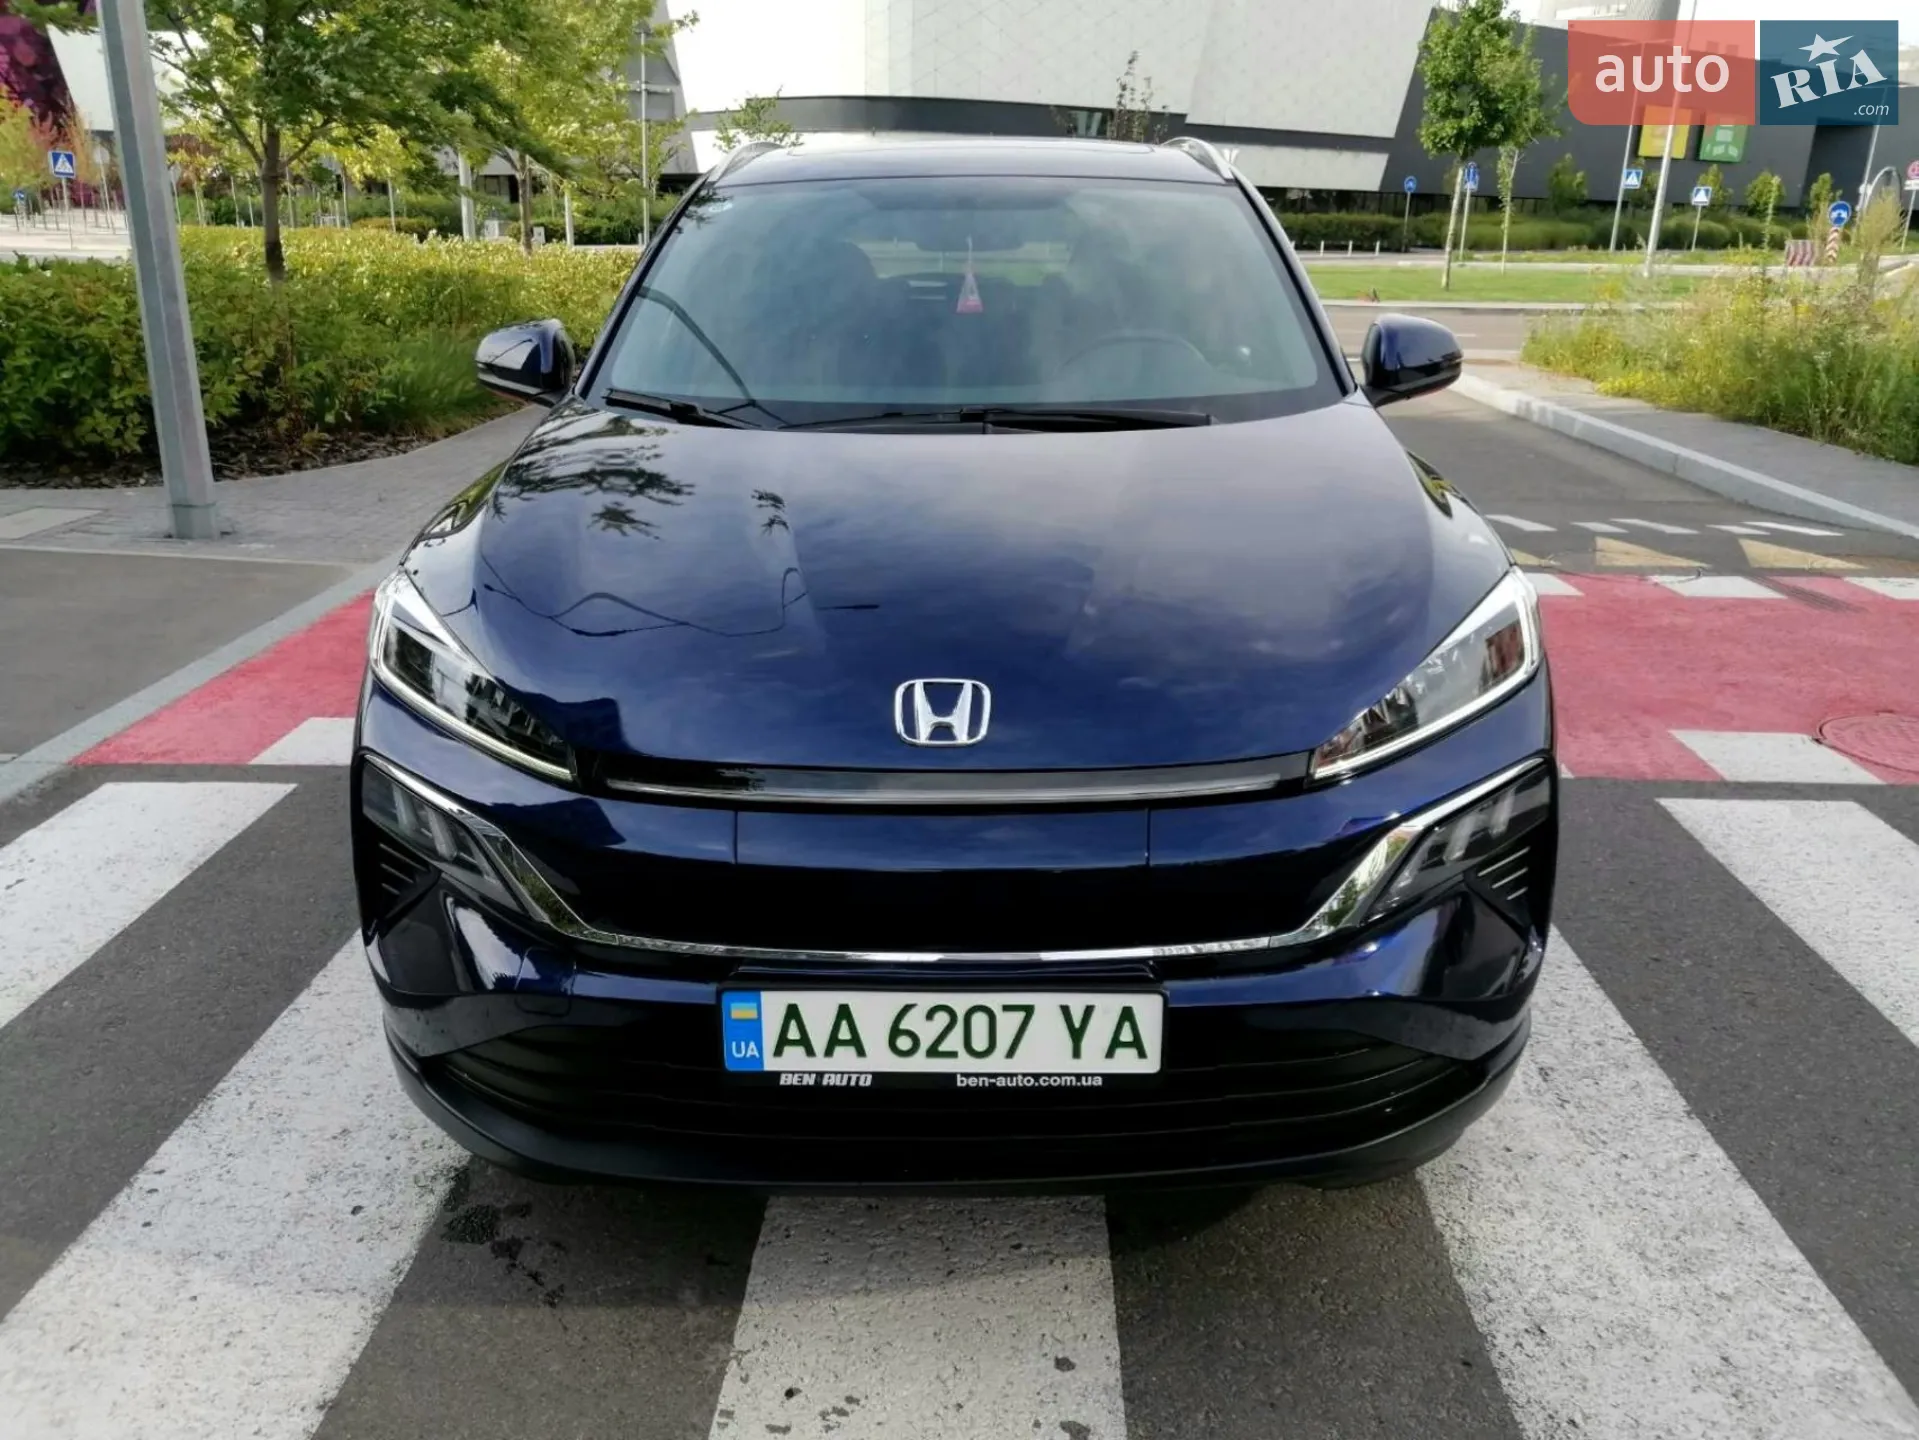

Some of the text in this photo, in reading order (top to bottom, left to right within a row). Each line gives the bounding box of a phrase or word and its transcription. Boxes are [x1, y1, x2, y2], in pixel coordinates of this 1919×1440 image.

[772, 1003, 1149, 1060] AA 6207 YA
[731, 1041, 760, 1058] UA
[779, 1073, 873, 1087] BEN AUTO
[956, 1073, 1103, 1087] ben-auto.com.ua
